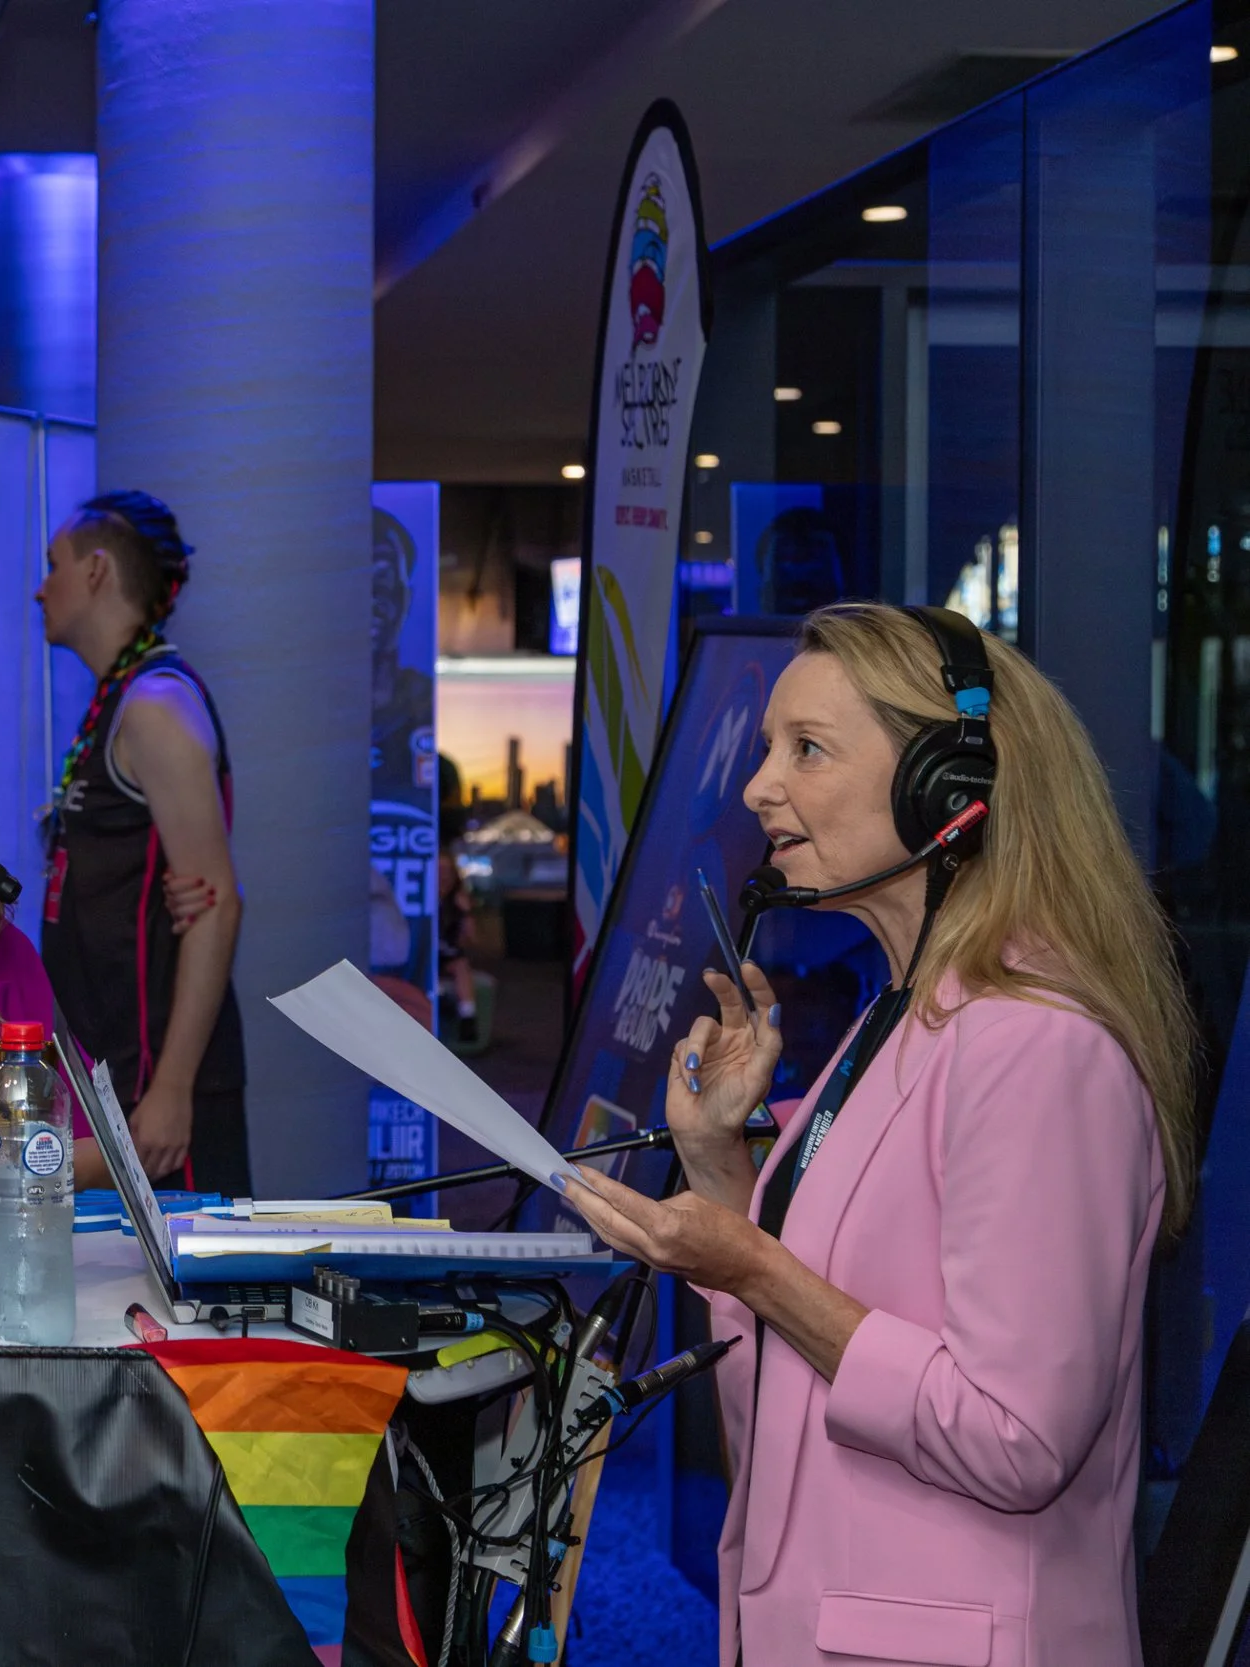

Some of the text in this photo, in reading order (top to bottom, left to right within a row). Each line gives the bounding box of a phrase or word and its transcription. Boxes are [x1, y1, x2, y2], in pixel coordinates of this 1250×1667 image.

[614, 946, 686, 1034] PRIDE
[800, 1132, 817, 1170] MELBOURNE
[810, 1112, 823, 1135] UNITED
